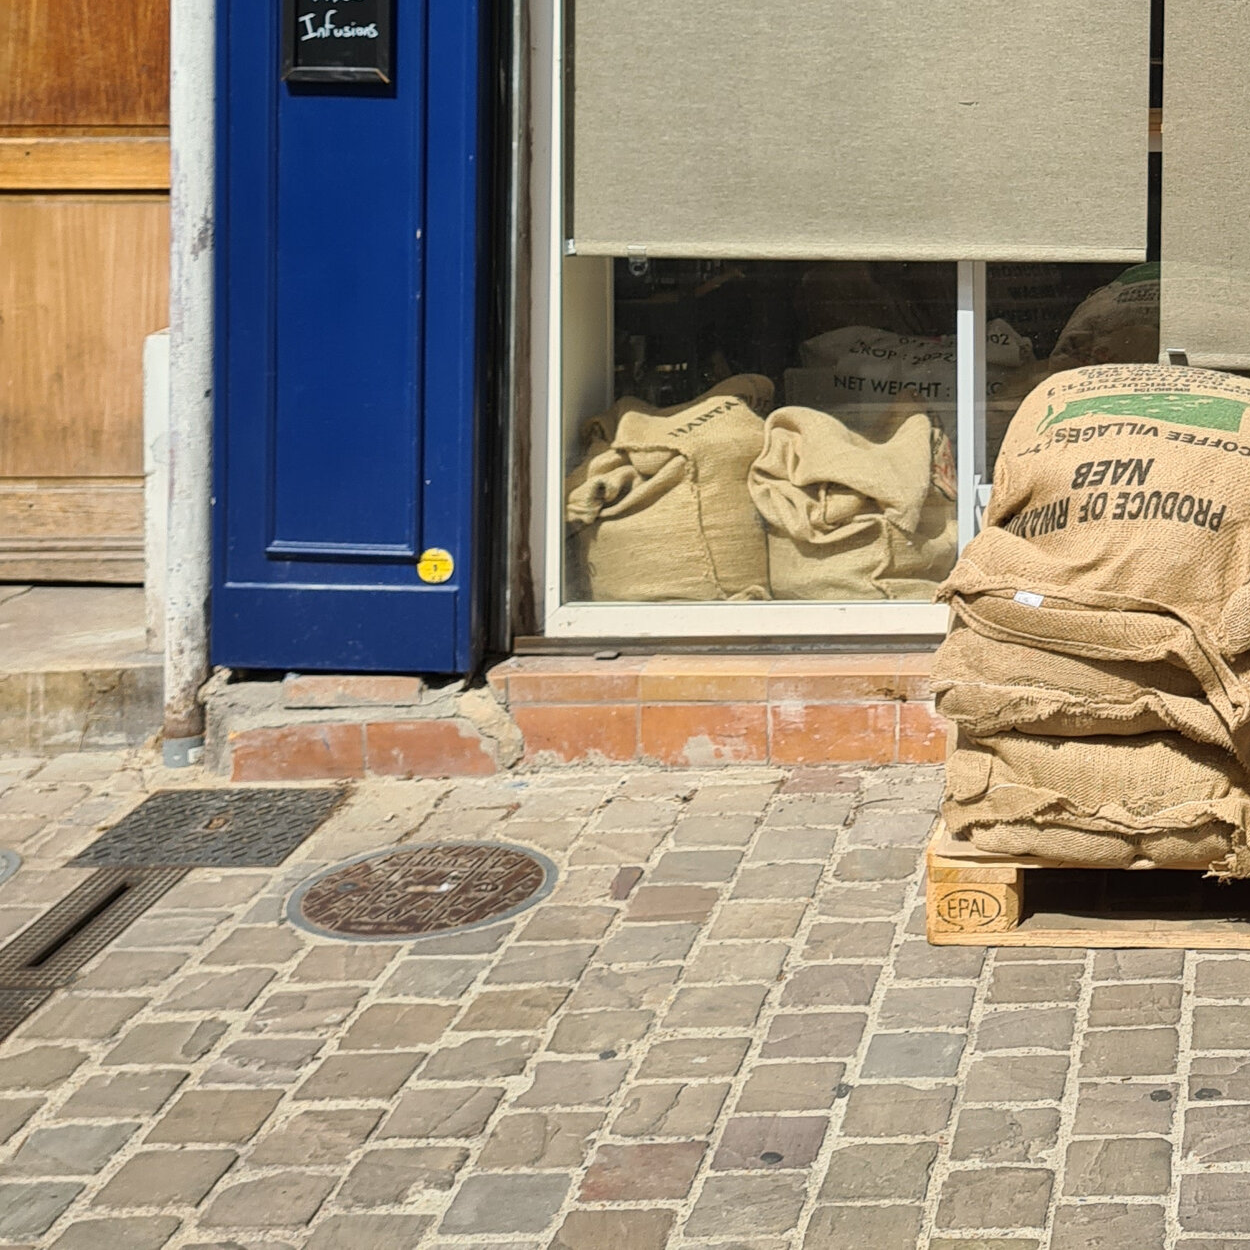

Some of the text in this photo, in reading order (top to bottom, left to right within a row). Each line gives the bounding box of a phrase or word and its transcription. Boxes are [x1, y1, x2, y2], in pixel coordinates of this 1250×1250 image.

[298, 9, 379, 42] Infusions
[833, 374, 867, 393] NET
[1054, 422, 1160, 446] VILLAGES
[1070, 457, 1156, 490] NAEB
[1076, 491, 1110, 525] OF
[1111, 491, 1228, 533] PRODUCE
[947, 897, 993, 919] EPAL
